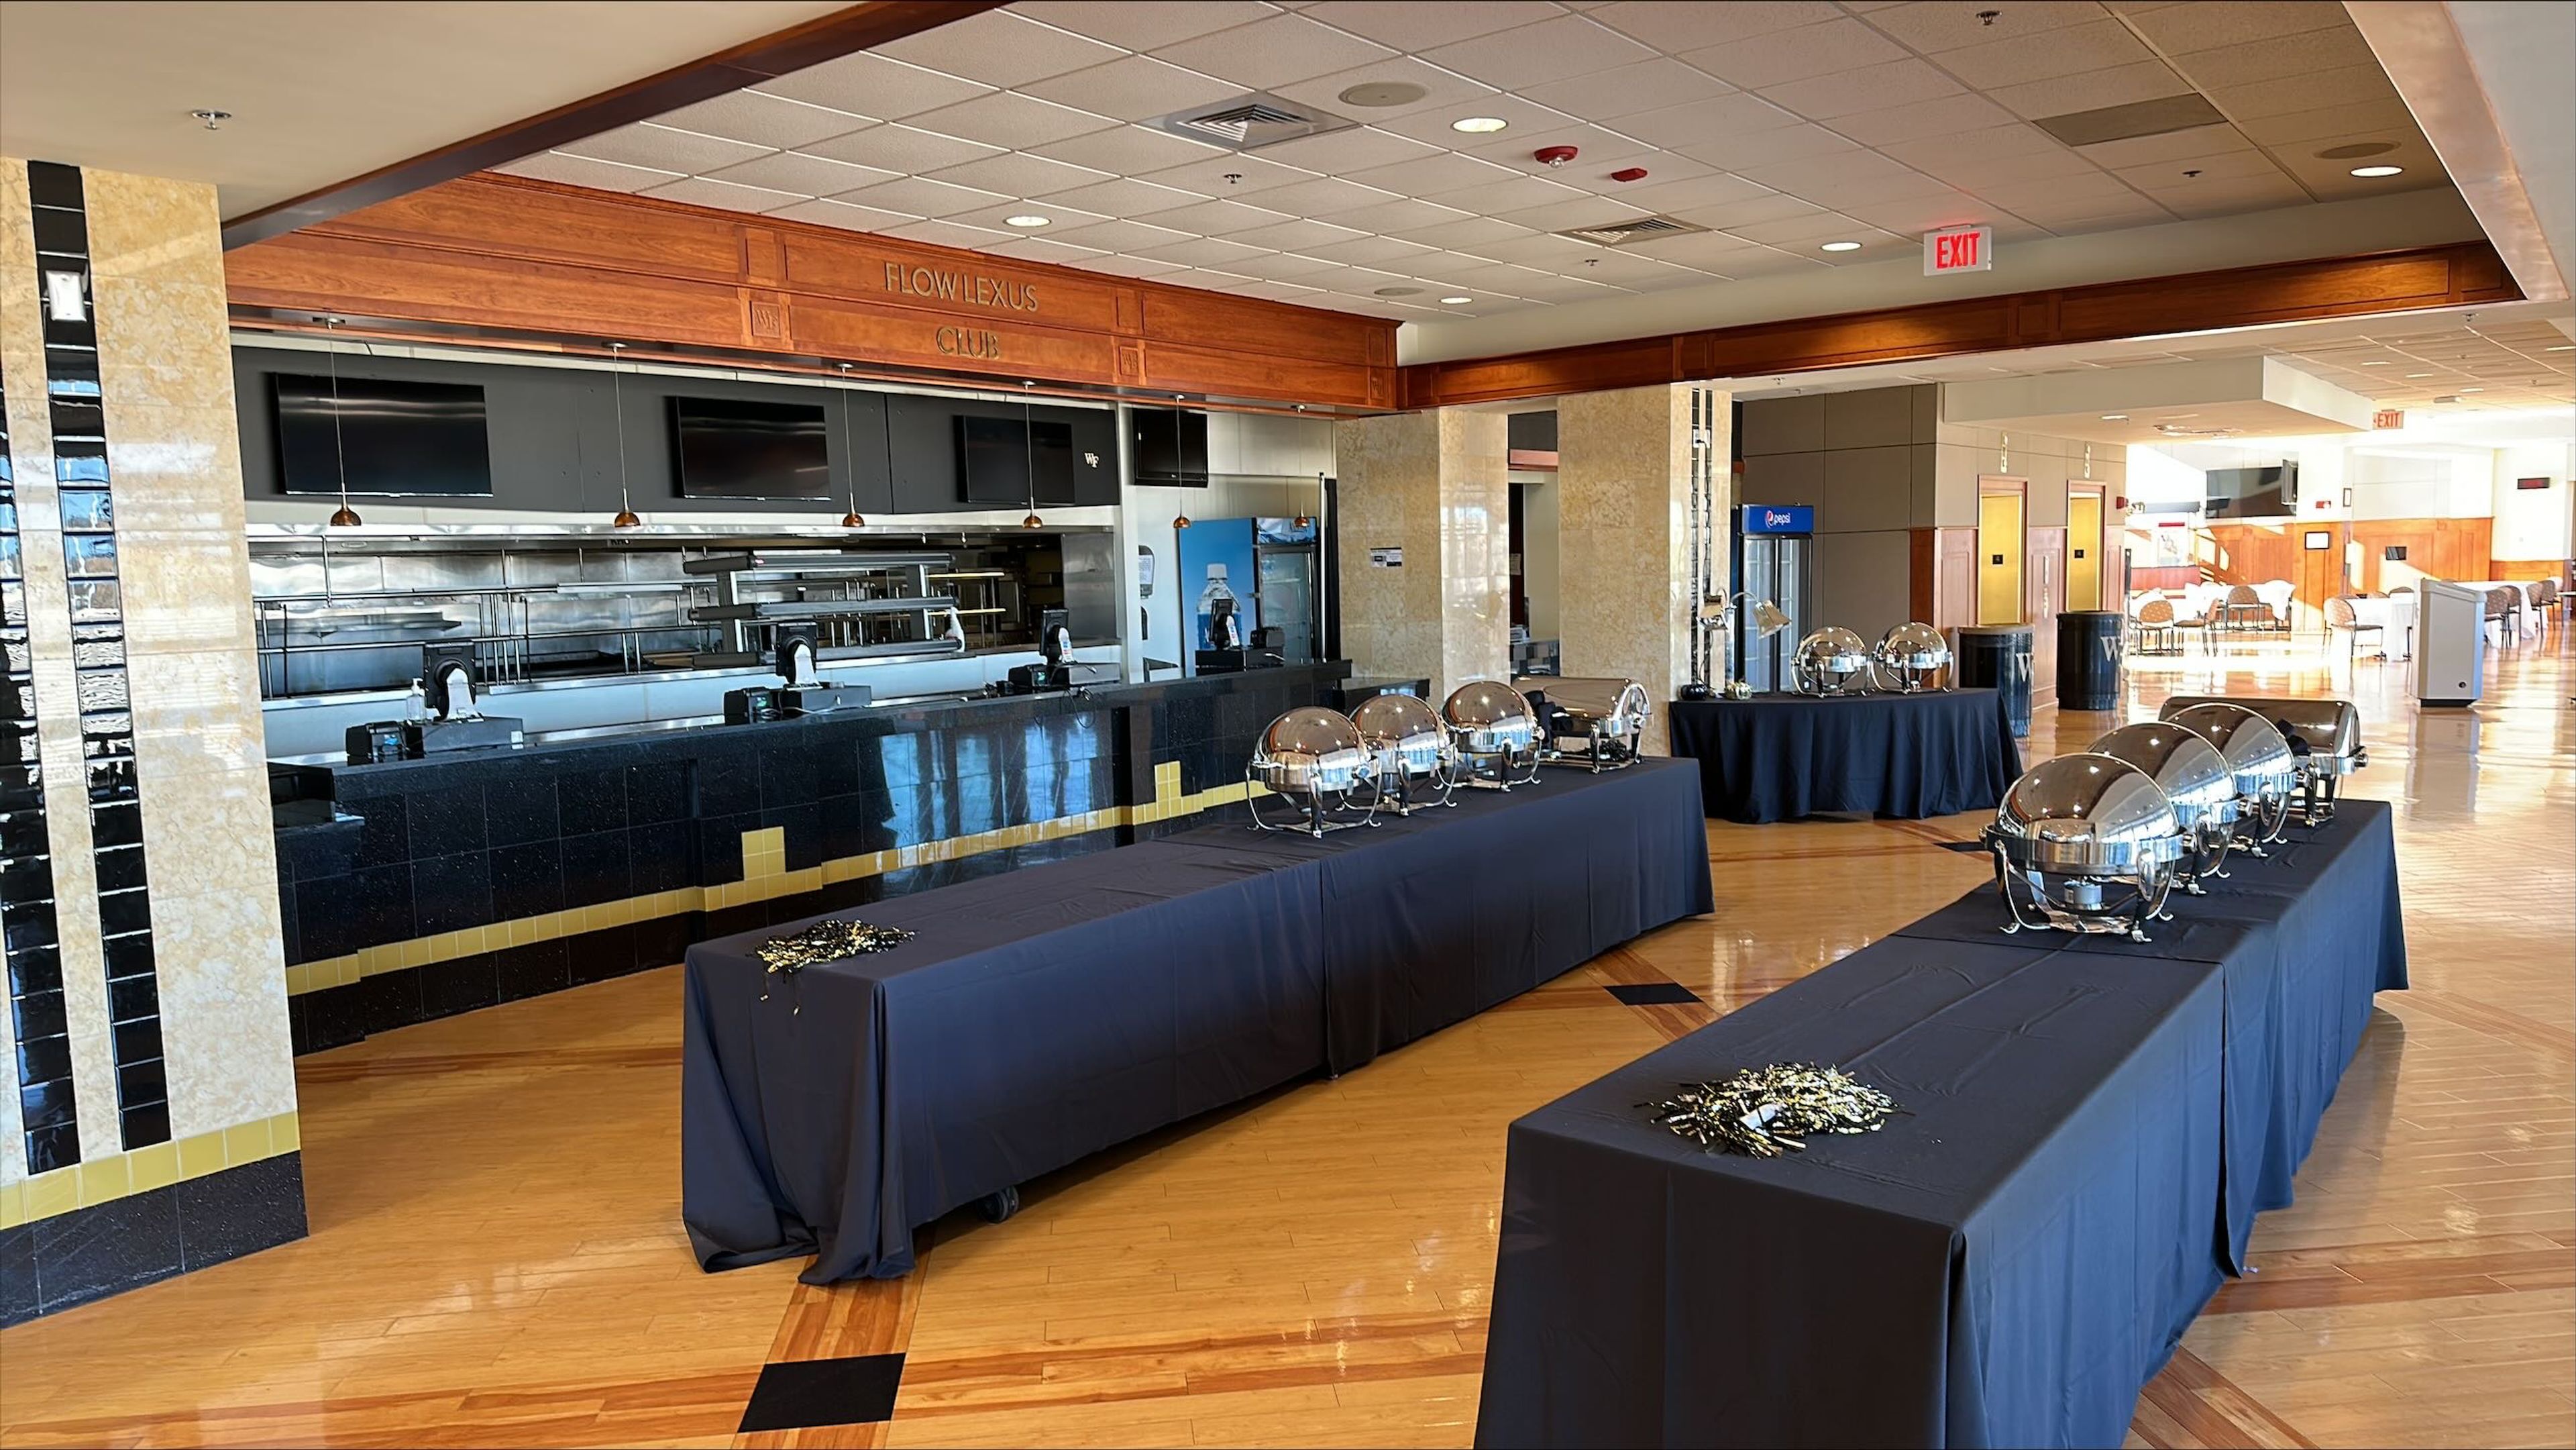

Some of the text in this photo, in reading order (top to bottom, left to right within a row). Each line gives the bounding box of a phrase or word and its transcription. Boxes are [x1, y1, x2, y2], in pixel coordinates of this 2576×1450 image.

[1936, 231, 1980, 269] EXIT
[885, 262, 1038, 313] FLOW LEXUS
[936, 326, 1000, 360] CLUB
[2377, 412, 2400, 427] EXIT
[1084, 452, 1099, 468] WF
[1773, 512, 1791, 526] pepsi
